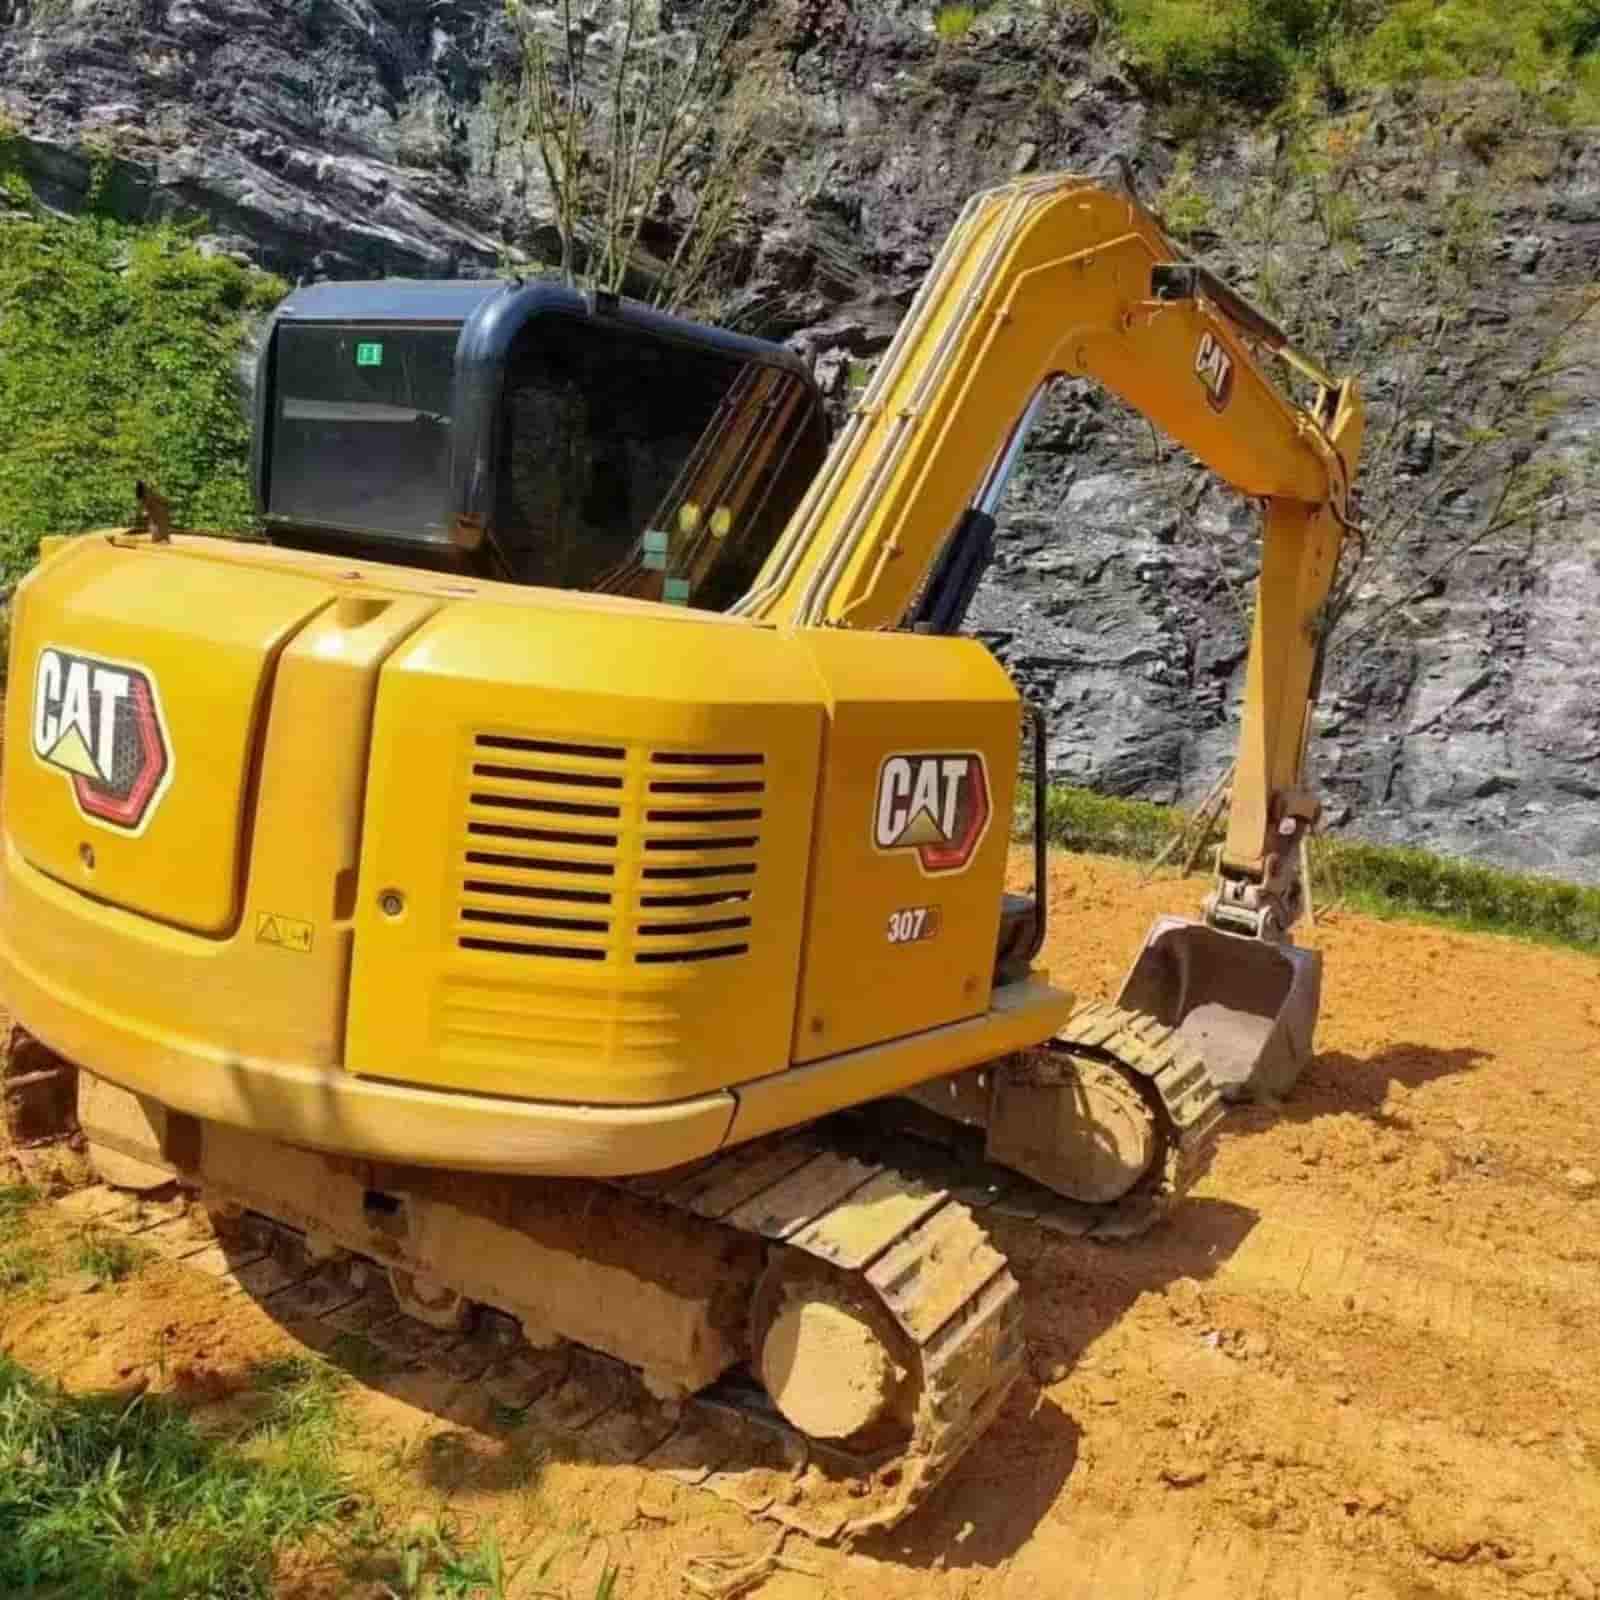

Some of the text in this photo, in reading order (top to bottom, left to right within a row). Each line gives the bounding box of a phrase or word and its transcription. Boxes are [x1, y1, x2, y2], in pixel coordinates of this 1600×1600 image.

[1195, 332, 1231, 397] CAT
[35, 650, 129, 782] CAT
[877, 757, 968, 845] CAT
[887, 908, 927, 943] 307
